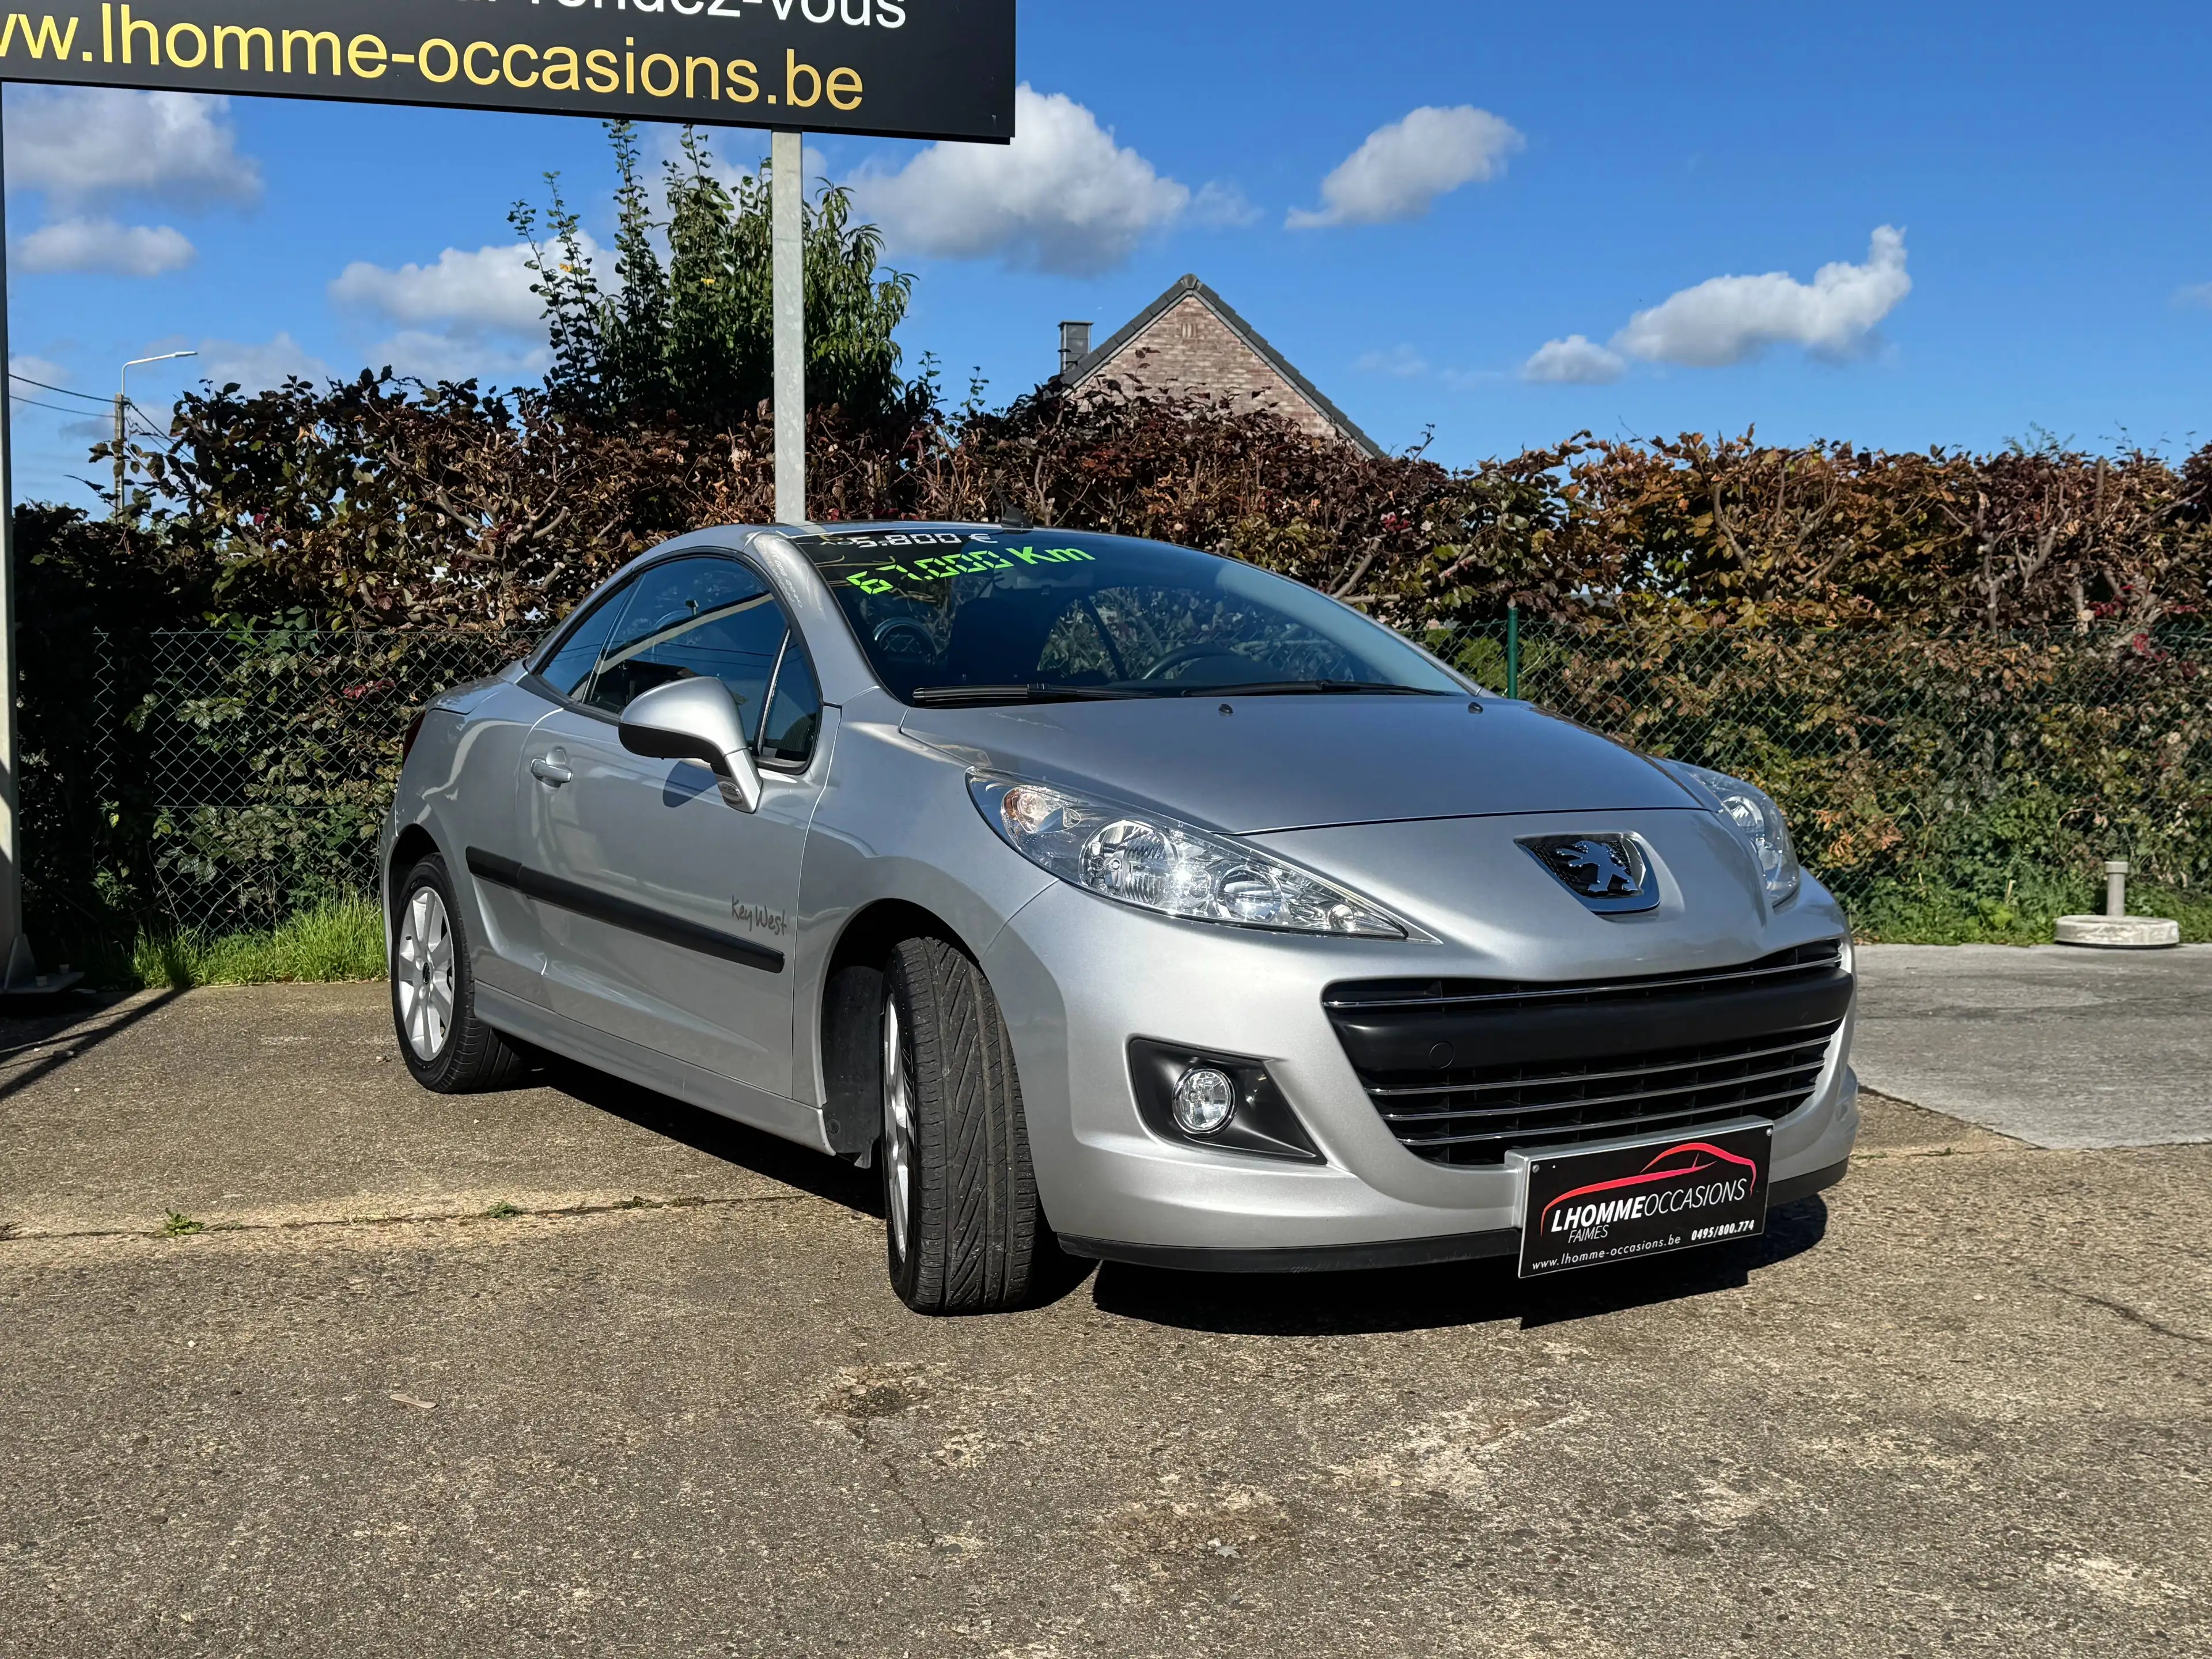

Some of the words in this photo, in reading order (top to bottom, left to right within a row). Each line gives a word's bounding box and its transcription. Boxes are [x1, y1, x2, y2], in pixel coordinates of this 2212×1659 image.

[0, 4, 863, 111] w.lhomme-occasions.be
[968, 533, 998, 543] €
[1005, 546, 1096, 565] Km
[1551, 1177, 1748, 1233] LHOMMEOCCASIONS
[1532, 1234, 1681, 1271] www.lhomme-occasions.be
[1691, 1219, 1755, 1242] 0495/800.774
[1567, 1224, 1609, 1244] FAIMES
